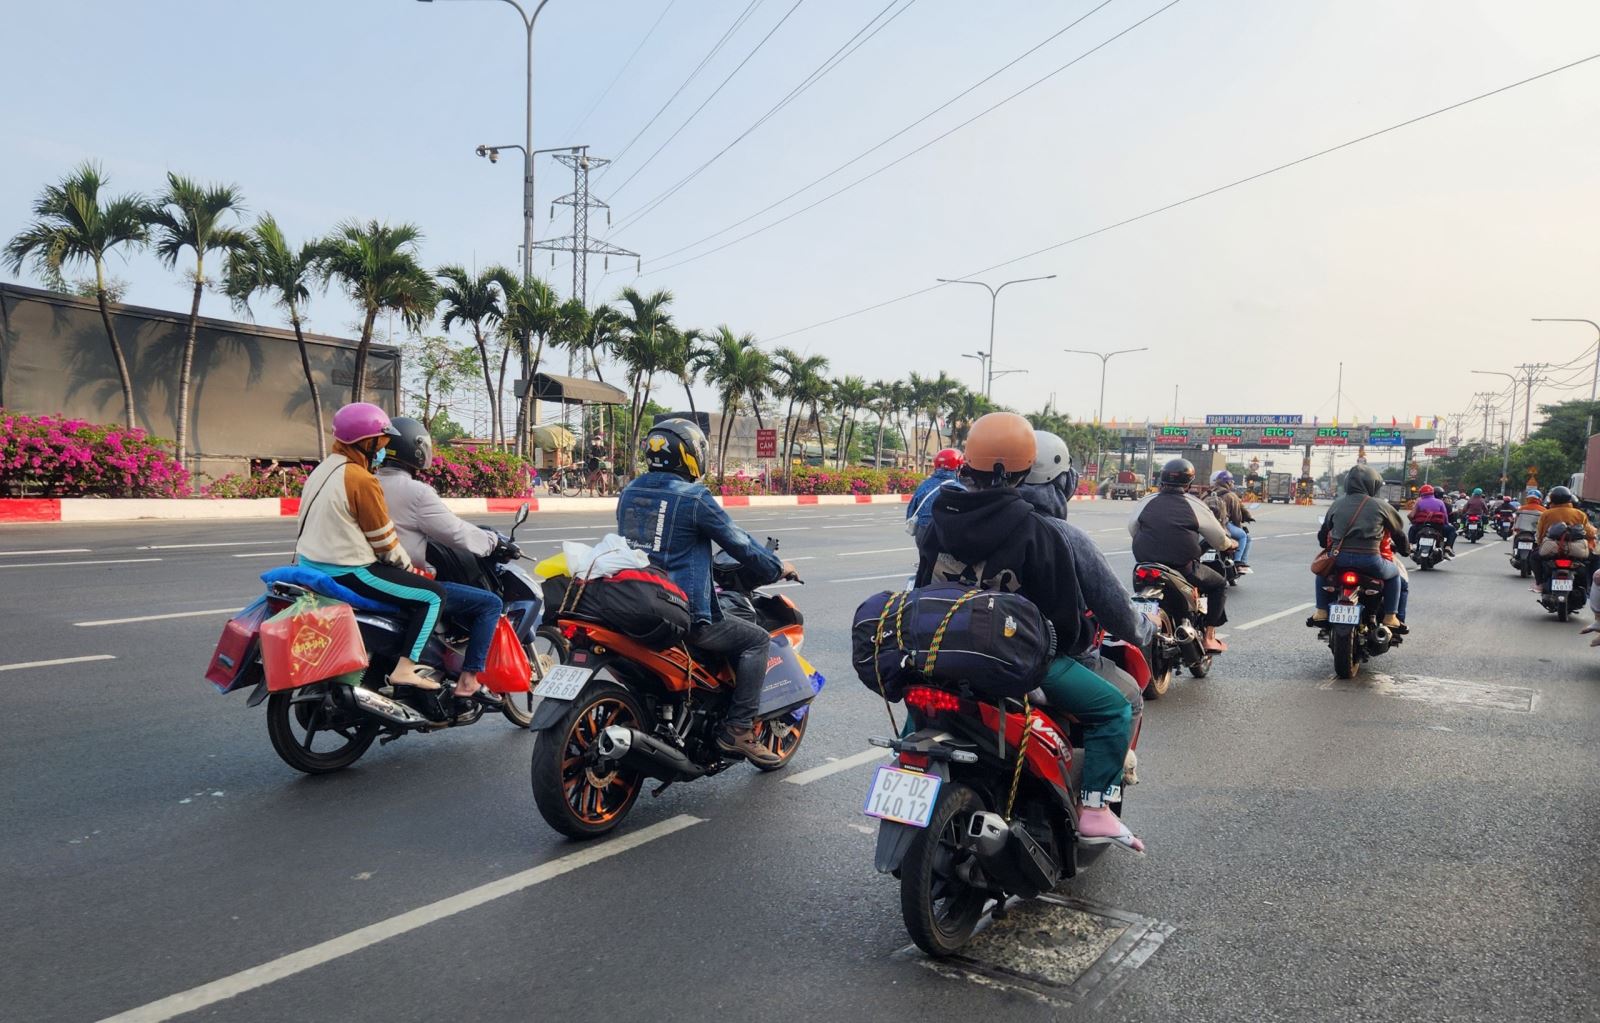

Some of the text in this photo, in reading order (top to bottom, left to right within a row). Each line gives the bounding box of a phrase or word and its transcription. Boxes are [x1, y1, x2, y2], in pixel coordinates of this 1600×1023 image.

[1279, 415, 1288, 424] AN
[1163, 427, 1180, 436] ETC
[1215, 427, 1233, 436] ETC
[1265, 428, 1284, 437] ETC
[1319, 428, 1338, 437] ETC
[882, 772, 930, 799] 67-D2
[873, 792, 928, 823] 140.12
